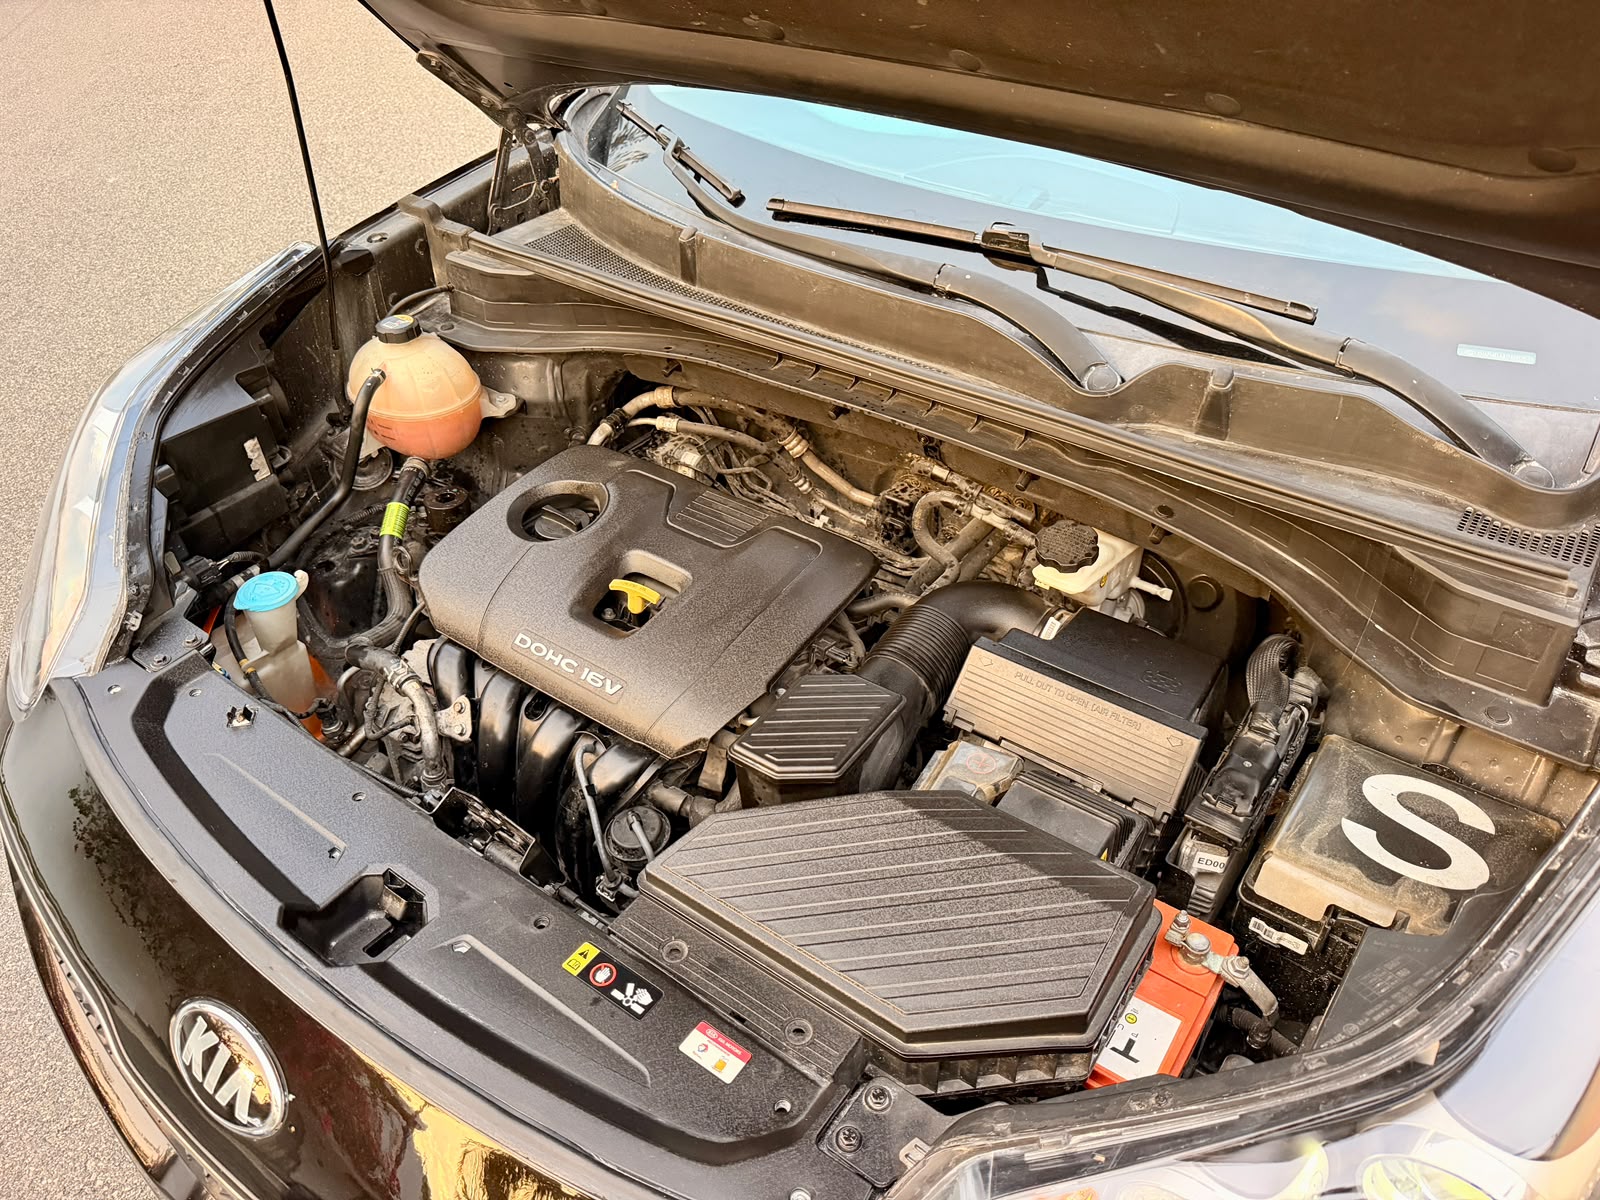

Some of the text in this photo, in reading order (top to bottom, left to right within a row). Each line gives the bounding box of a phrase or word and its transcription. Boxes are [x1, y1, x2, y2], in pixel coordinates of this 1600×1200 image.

[513, 632, 624, 696] DOHC 16V
[1014, 671, 1034, 685] PULL
[1035, 680, 1053, 692] OUT
[1054, 687, 1065, 698] TO
[1066, 692, 1089, 708] OPEN
[1340, 773, 1496, 891] S
[181, 1015, 256, 1125] KIA
